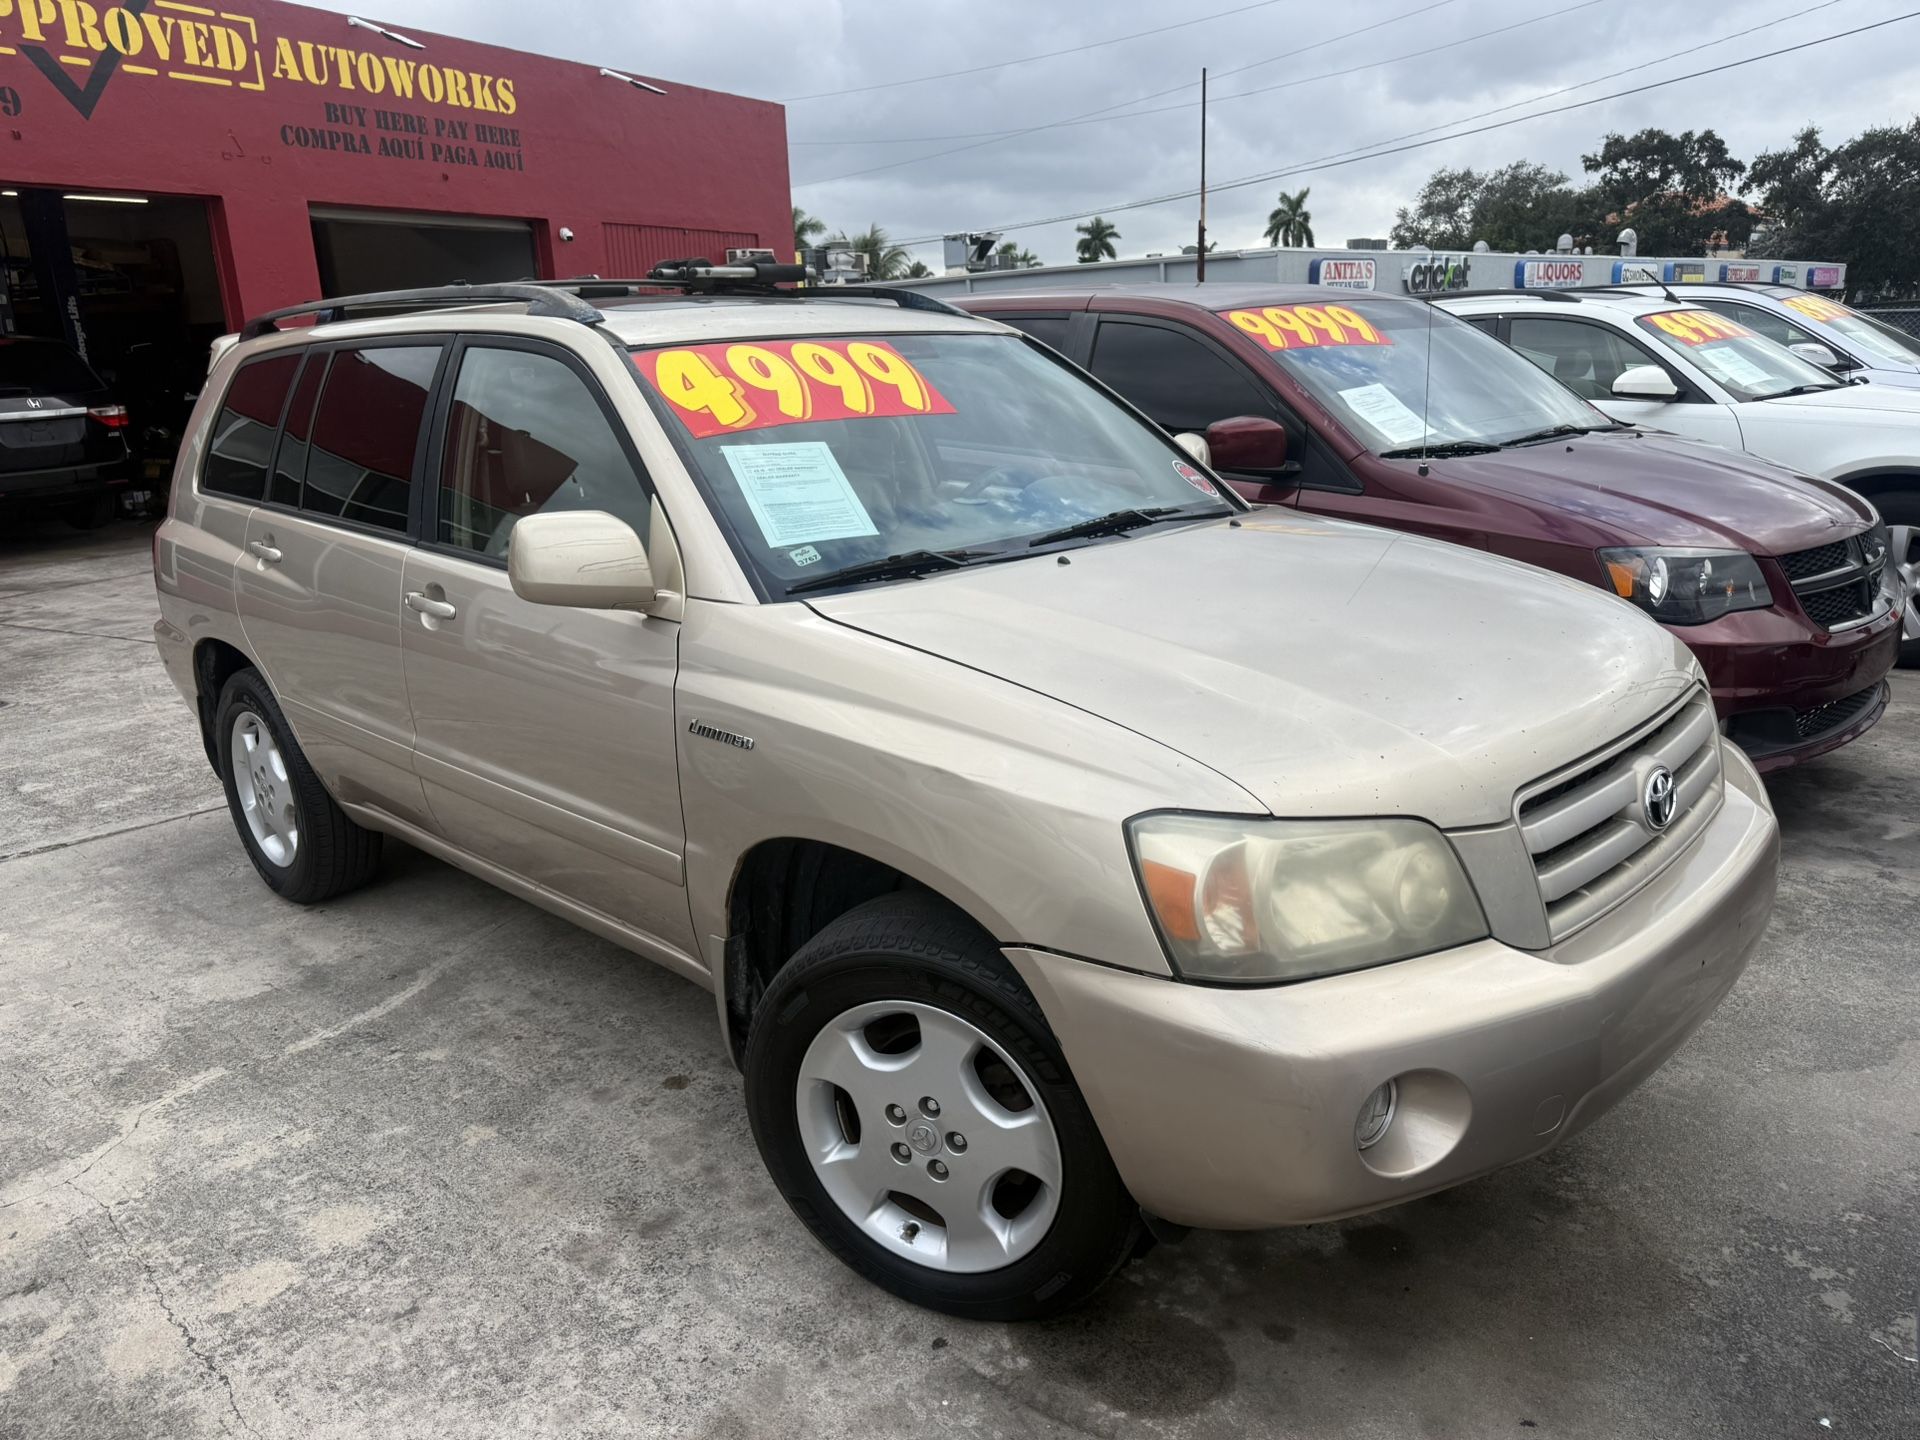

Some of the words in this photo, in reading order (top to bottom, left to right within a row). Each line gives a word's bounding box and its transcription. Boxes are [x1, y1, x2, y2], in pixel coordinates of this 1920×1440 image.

[272, 37, 517, 115] AUTOWORKS
[324, 102, 368, 128] BUY
[374, 109, 429, 136] HERE
[433, 118, 468, 141] PAY
[475, 123, 522, 148] HERE
[280, 124, 372, 154] COMPRA
[378, 131, 425, 161] AQUÍ
[430, 143, 479, 167] PAGA
[484, 145, 525, 172] AQUÍ
[1323, 262, 1374, 280] ANITA'S
[1409, 256, 1471, 291] cricket
[1536, 263, 1582, 281] LIQUORS
[1228, 305, 1380, 349] 9999
[655, 342, 932, 428] 4999
